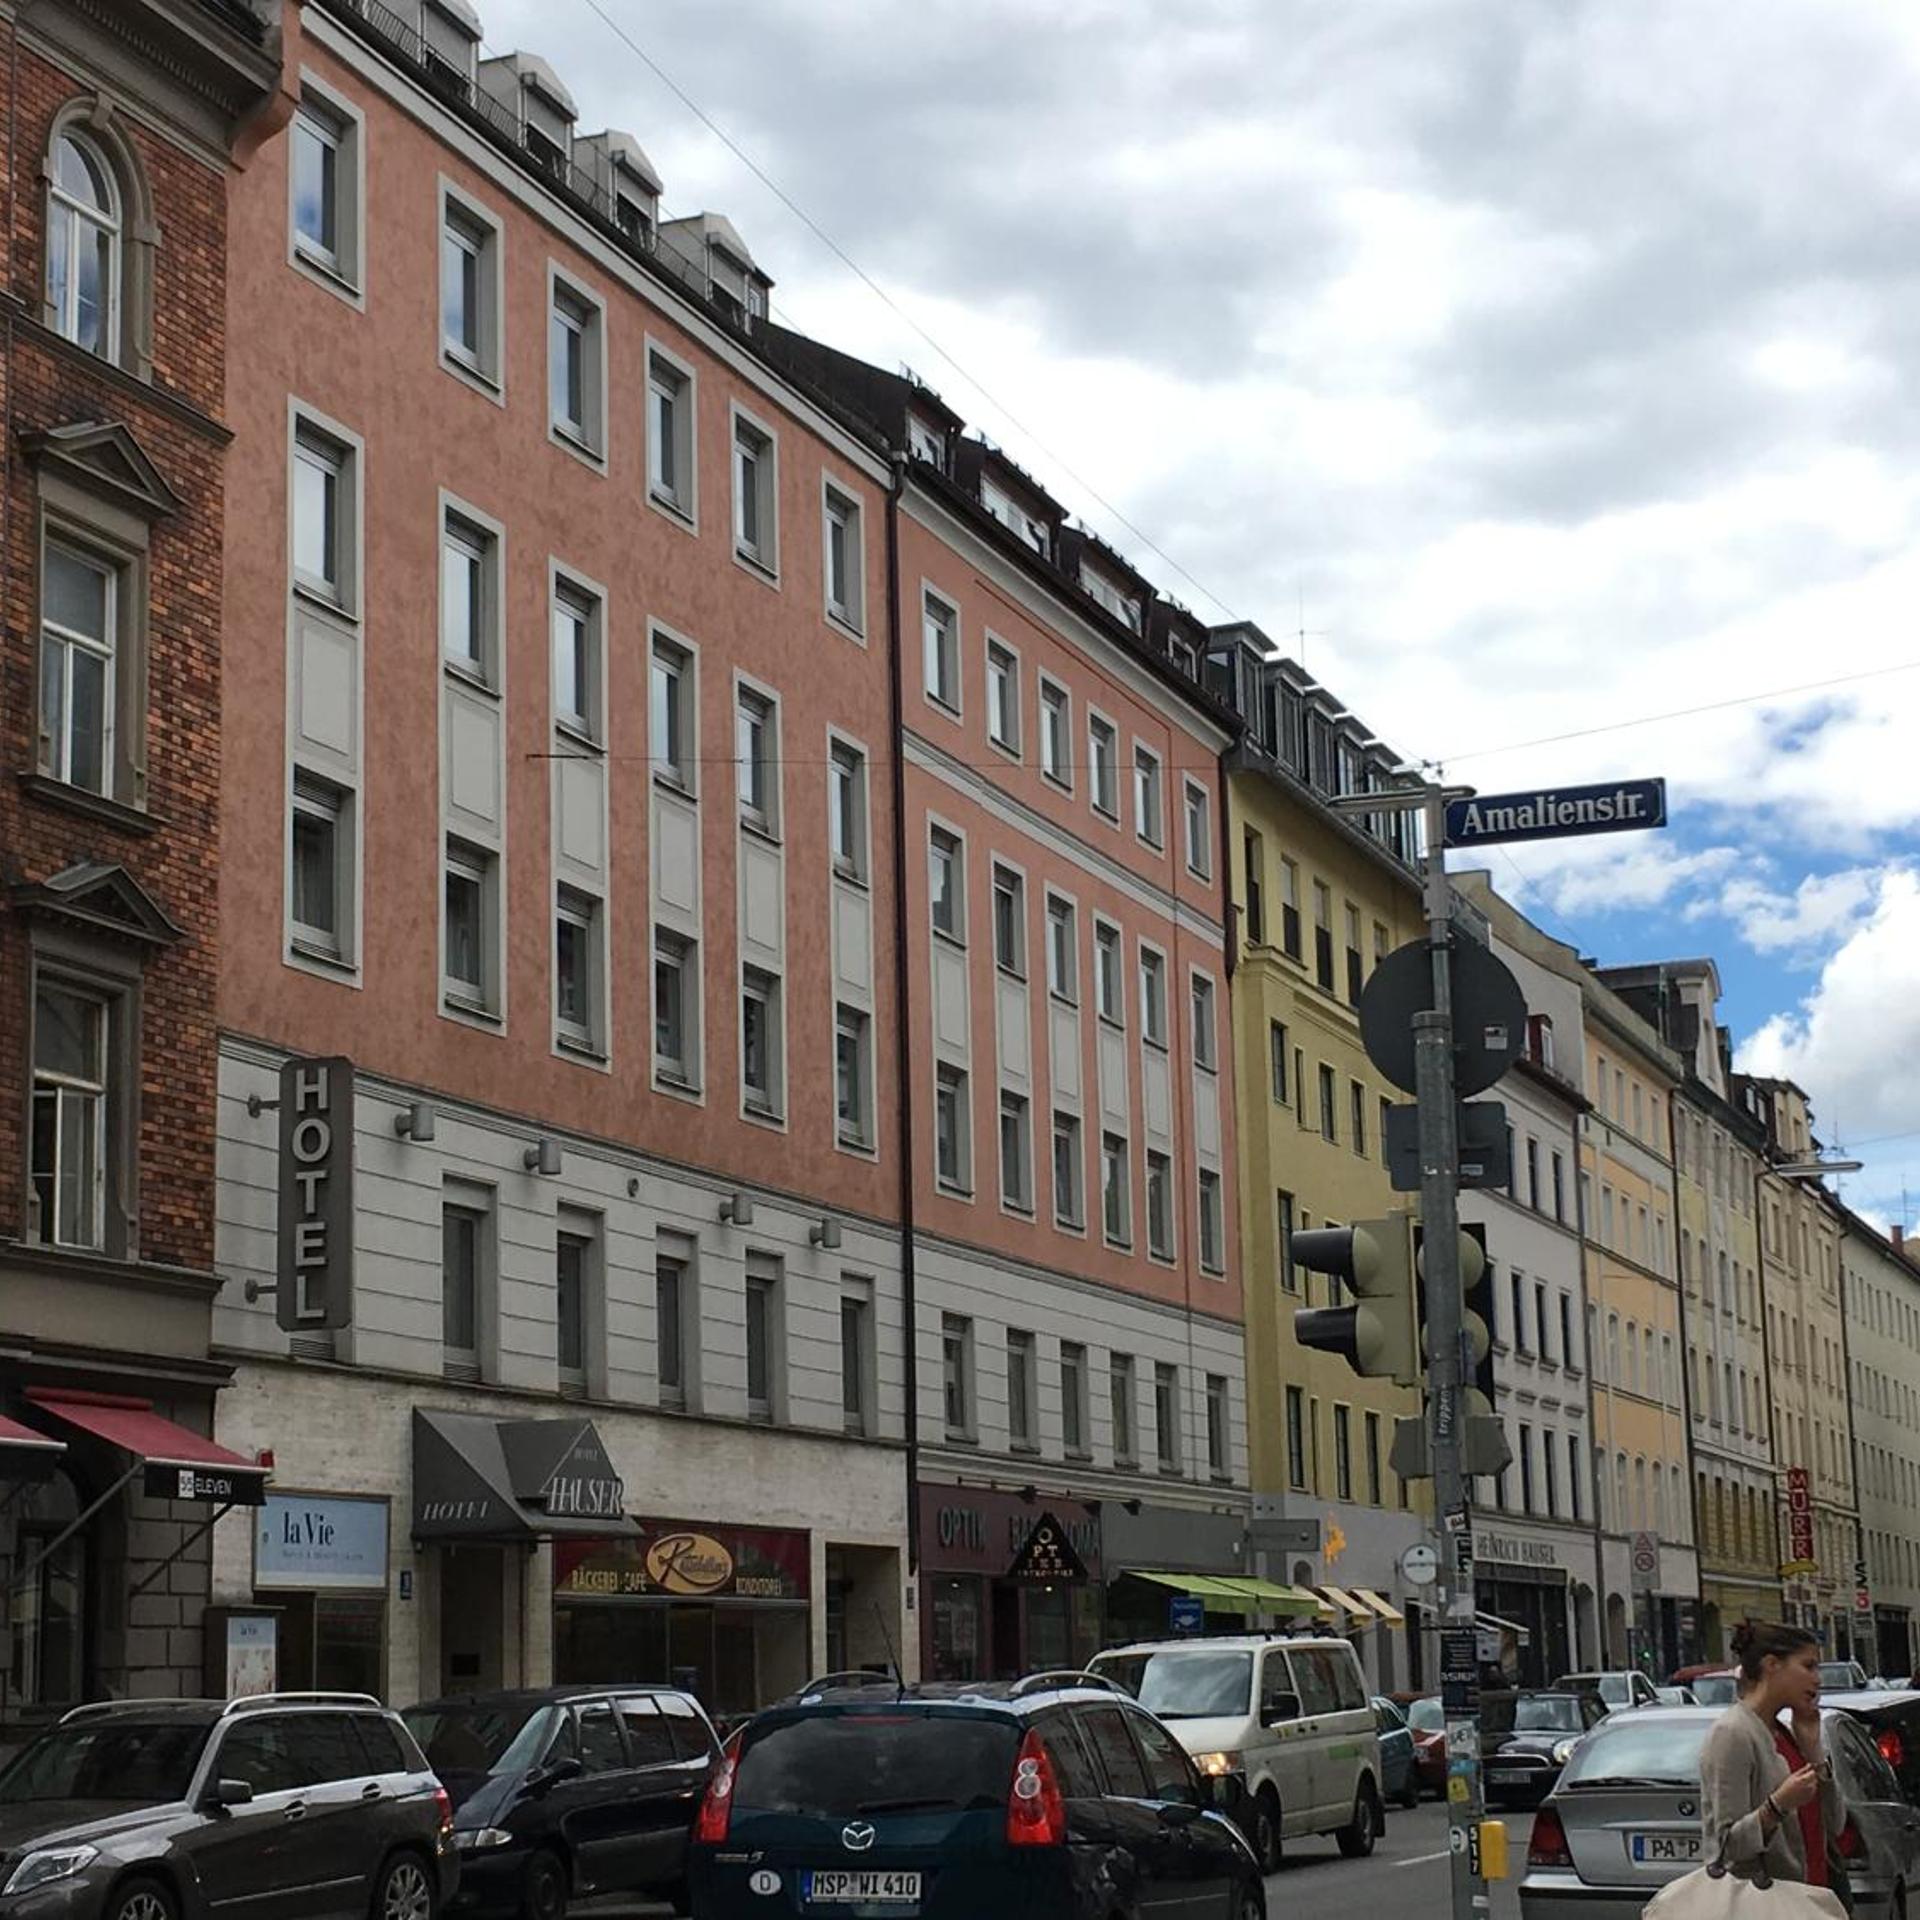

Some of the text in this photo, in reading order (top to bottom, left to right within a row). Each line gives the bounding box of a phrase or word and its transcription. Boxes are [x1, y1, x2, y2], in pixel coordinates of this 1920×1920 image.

[1461, 789, 1647, 836] Amalienstr.
[292, 1066, 331, 1319] HOTEL
[195, 1477, 232, 1496] ELEVEN
[549, 1477, 624, 1514] HAUSER
[284, 1511, 335, 1546] la Vie
[1789, 1474, 1809, 1557] MURR
[1651, 1839, 1675, 1858] PA
[759, 1873, 771, 1891] D
[813, 1874, 917, 1896] MSP WI 410
